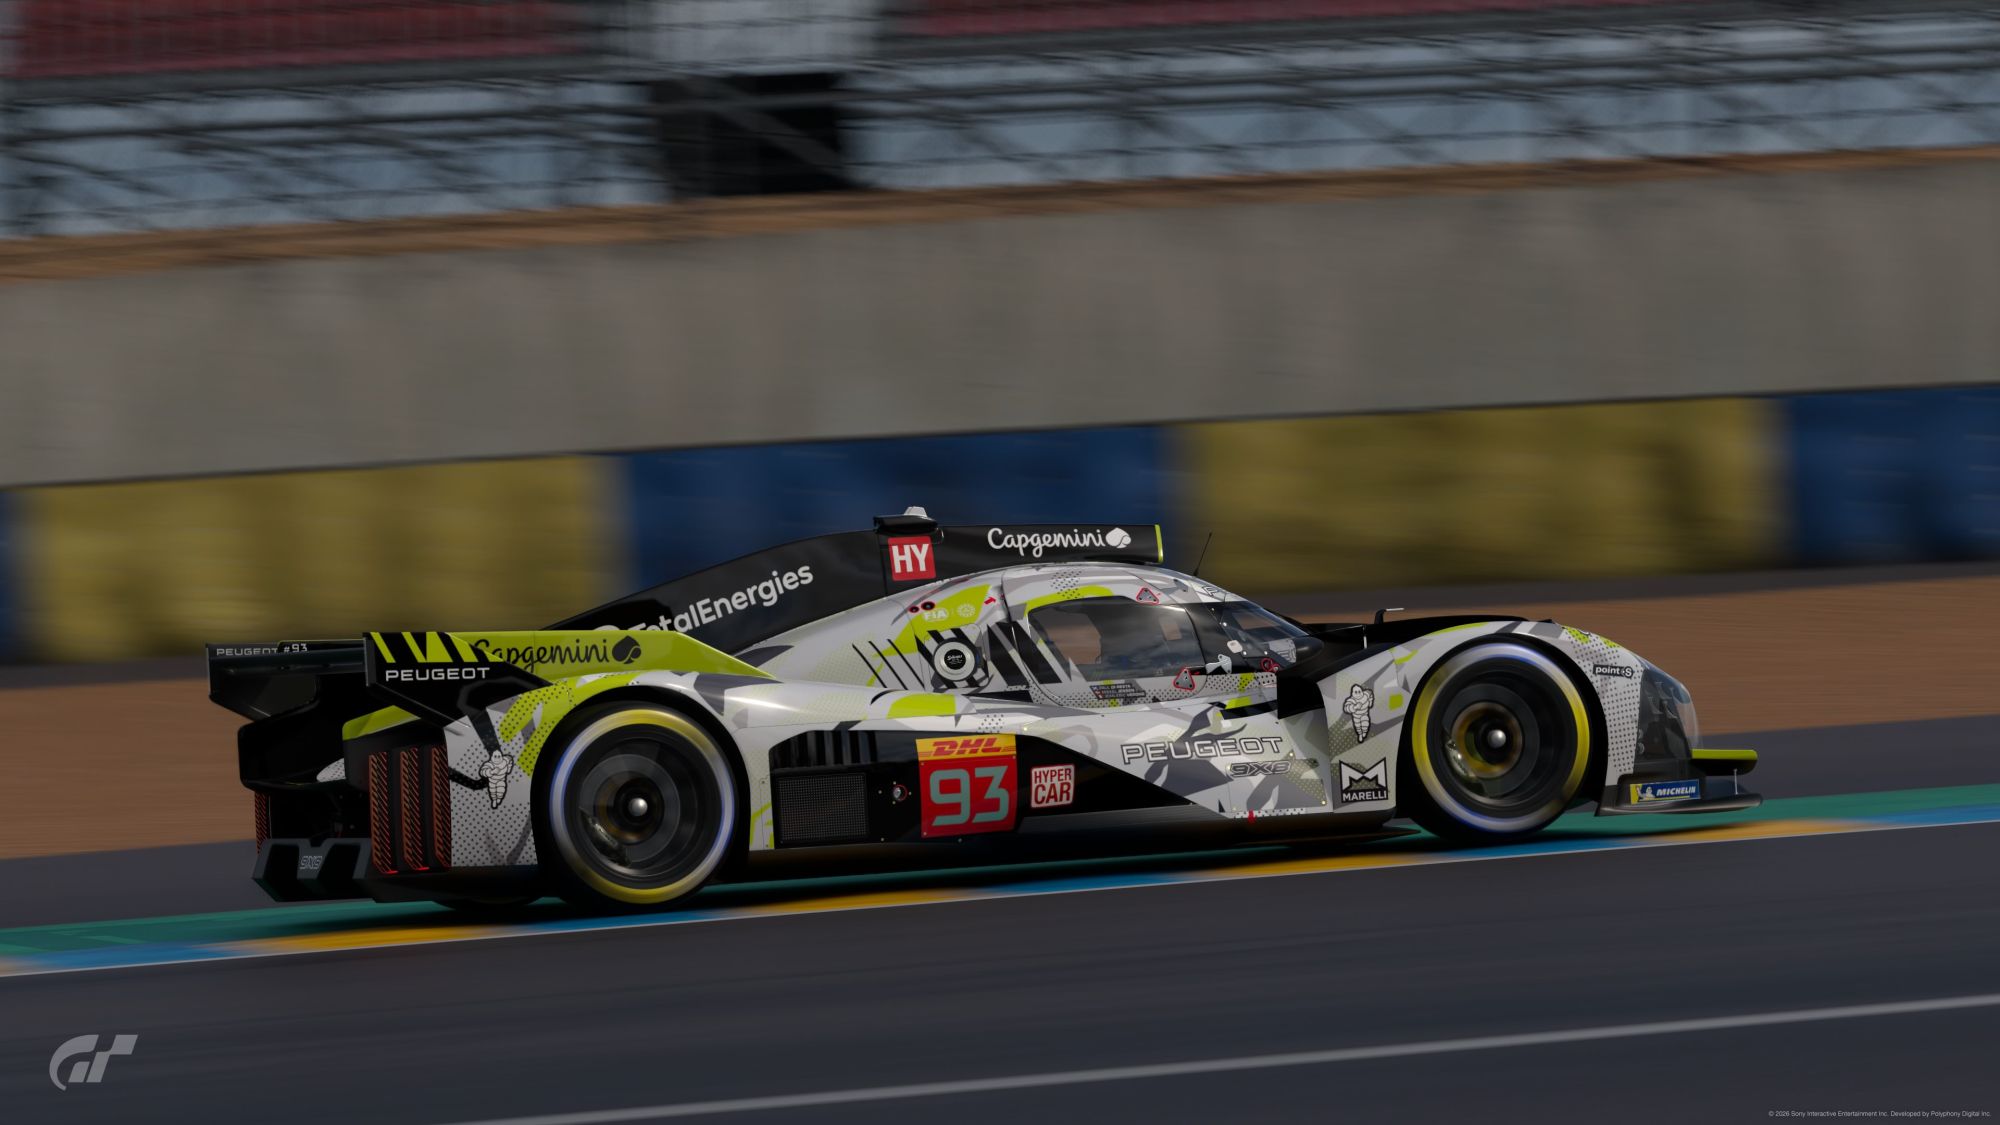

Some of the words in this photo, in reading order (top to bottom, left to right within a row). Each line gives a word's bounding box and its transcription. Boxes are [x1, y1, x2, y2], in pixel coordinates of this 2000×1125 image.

[987, 527, 1105, 558] Capgemini
[891, 543, 929, 574] HY
[385, 667, 490, 681] PEUGEOT
[932, 737, 1001, 757] DHL
[1121, 737, 1282, 765] PEUGEOT
[1034, 768, 1072, 783] HYPER
[929, 765, 1010, 826] 93
[1034, 781, 1071, 804] CAR
[1342, 791, 1387, 801] MARELLI
[1656, 786, 1696, 796] MICHELIN
